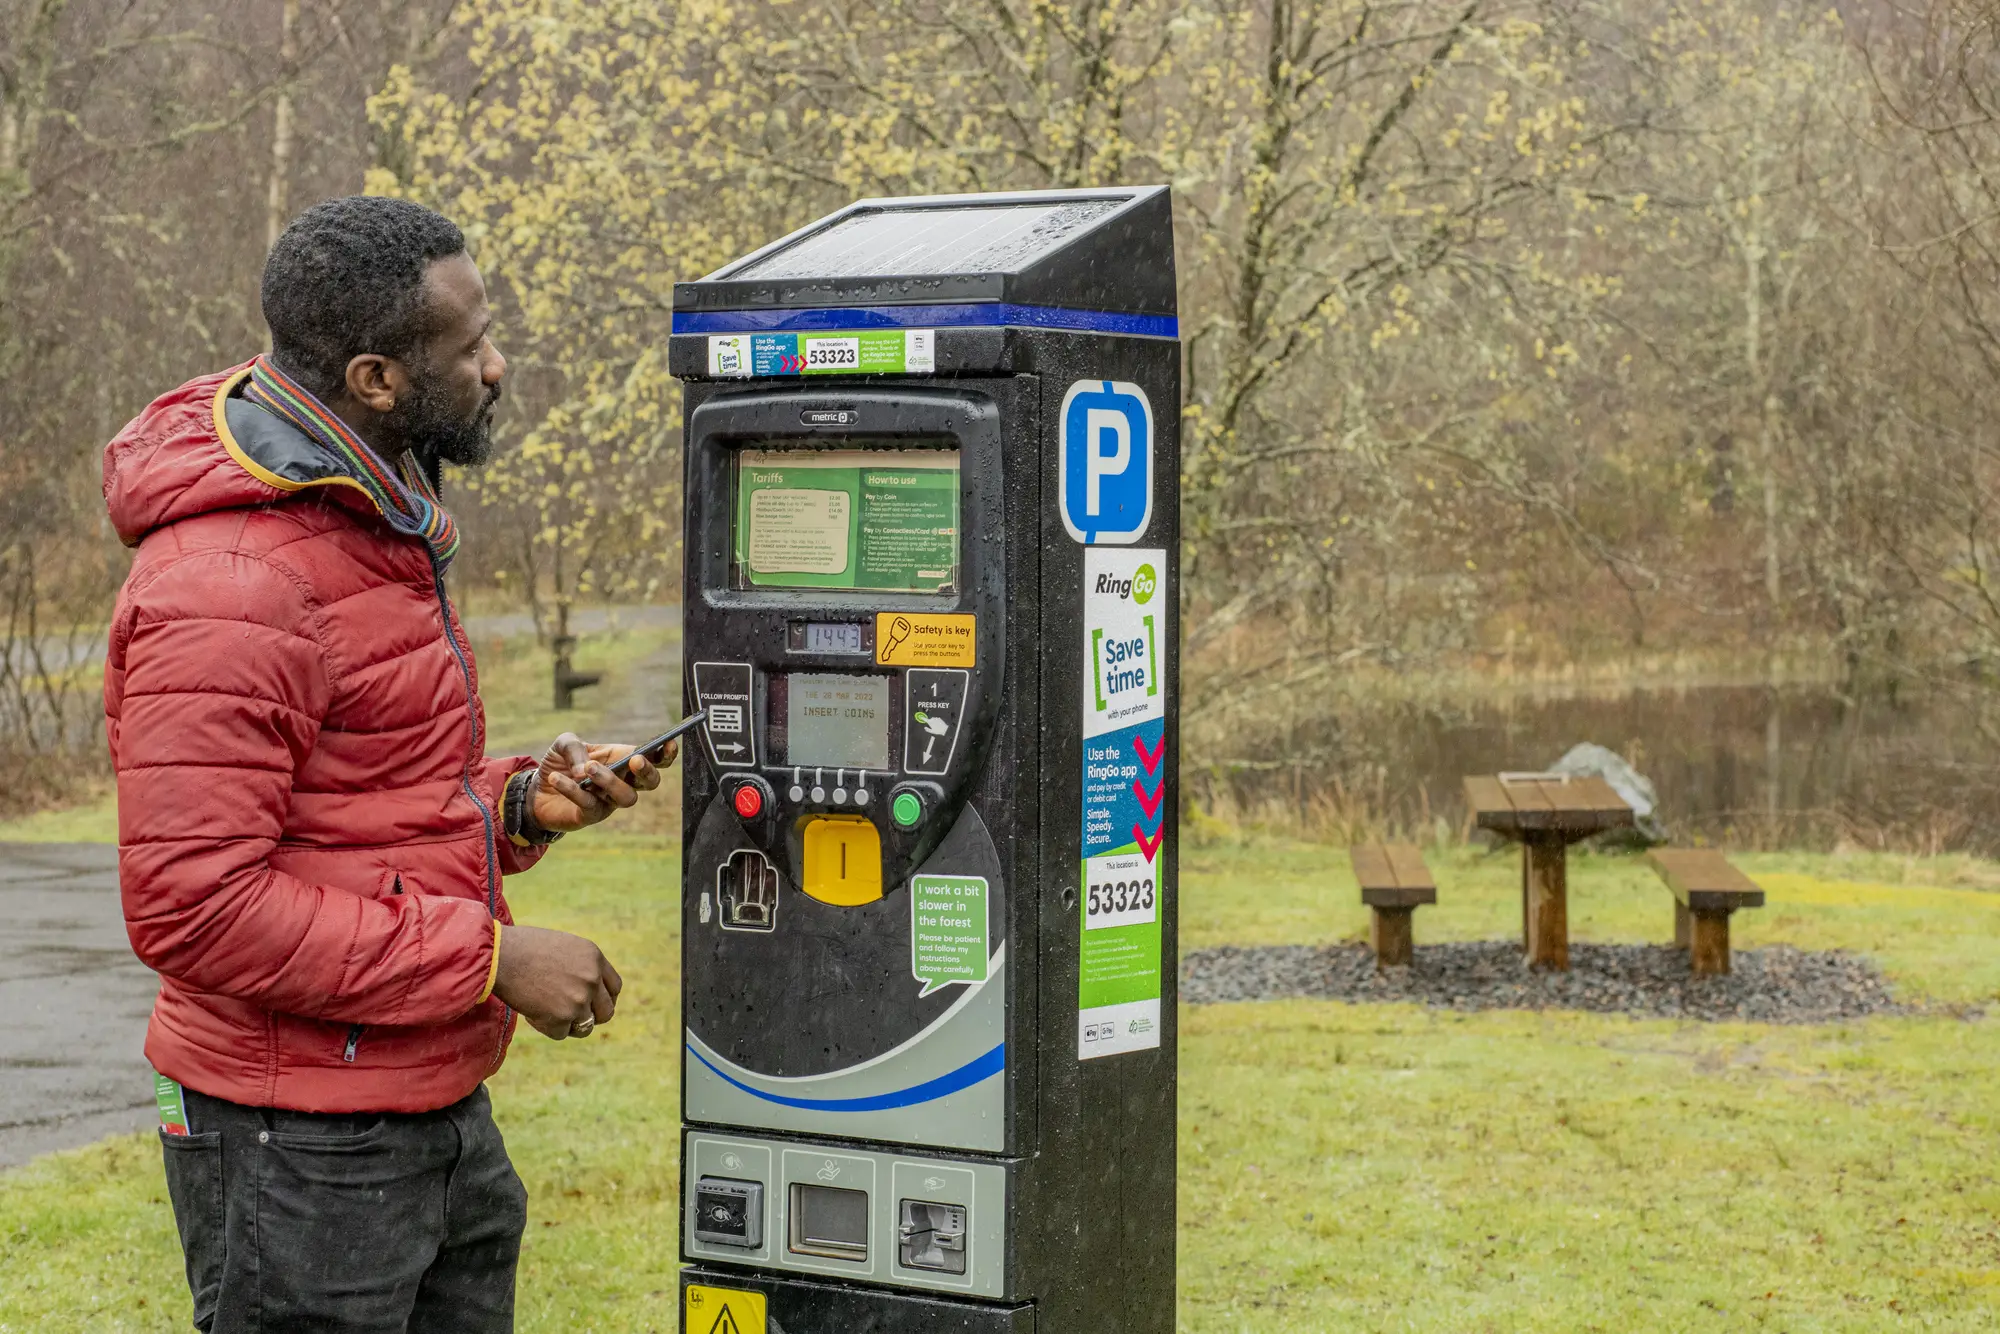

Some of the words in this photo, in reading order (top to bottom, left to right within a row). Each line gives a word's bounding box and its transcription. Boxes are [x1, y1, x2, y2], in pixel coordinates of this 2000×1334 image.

[722, 355, 736, 363] Save
[810, 350, 855, 364] 53323
[812, 413, 838, 421] metric
[1086, 408, 1131, 516] P
[752, 473, 783, 483] Tariffs
[869, 476, 889, 484] How
[1095, 573, 1154, 600] RingGo
[914, 625, 943, 636] Safety
[946, 626, 952, 634] is
[955, 626, 970, 637] key
[1106, 638, 1144, 665] Save
[1107, 665, 1144, 694] time
[805, 691, 818, 699] TUE
[836, 692, 850, 700] MAR
[931, 683, 937, 696] 1
[700, 692, 722, 700] FOLLOW
[804, 706, 838, 717] INSERT
[845, 709, 875, 719] COINS
[1108, 708, 1119, 720] with
[1119, 707, 1132, 719] your
[1132, 702, 1148, 716] phone
[1088, 748, 1104, 761] Use
[1105, 746, 1120, 760] the
[1088, 764, 1119, 780] RingGo
[1121, 766, 1137, 778] app
[1087, 784, 1096, 792] and
[1097, 785, 1105, 793] pay
[1106, 783, 1113, 792] by
[1113, 781, 1126, 790] credit
[1093, 794, 1105, 803] debit
[1106, 793, 1116, 802] card
[1087, 807, 1111, 820] Simple.
[1087, 820, 1114, 834] Speedy.
[1086, 834, 1111, 844] Secure.
[1116, 861, 1133, 869] location
[919, 884, 922, 894] I
[925, 885, 951, 895] work
[965, 885, 979, 896] bit
[1088, 879, 1153, 916] 53323
[919, 900, 953, 910] slower
[957, 901, 966, 912] in
[919, 915, 936, 926] the
[940, 916, 971, 928] forest
[919, 933, 942, 941] Please
[944, 934, 953, 942] be
[955, 935, 981, 944] patient
[958, 947, 968, 955] my
[919, 954, 960, 963] instructions
[943, 966, 974, 975] carefully
